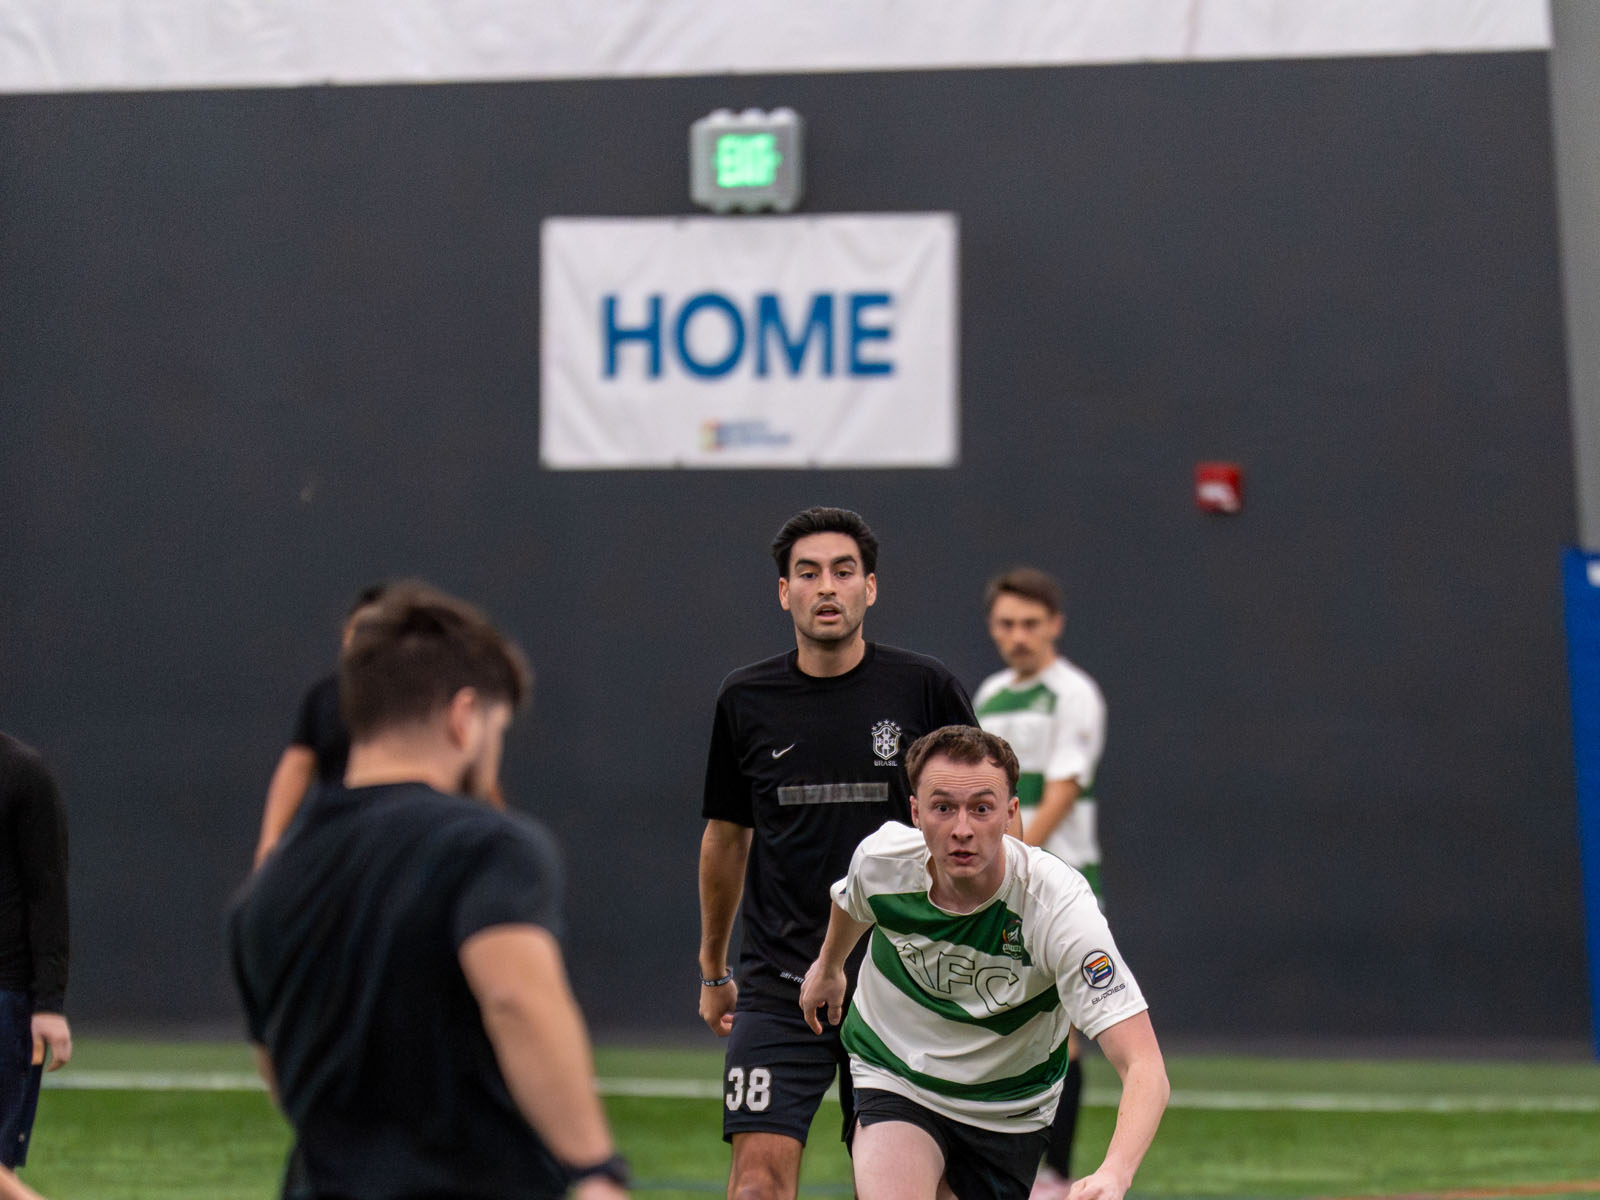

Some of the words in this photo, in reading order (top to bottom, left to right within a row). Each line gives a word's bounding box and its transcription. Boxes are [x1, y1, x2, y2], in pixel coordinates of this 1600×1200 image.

[603, 292, 894, 380] HOME
[899, 943, 1019, 1014] AFC
[1091, 983, 1126, 1005] BUDDIES
[725, 1067, 771, 1111] 38
